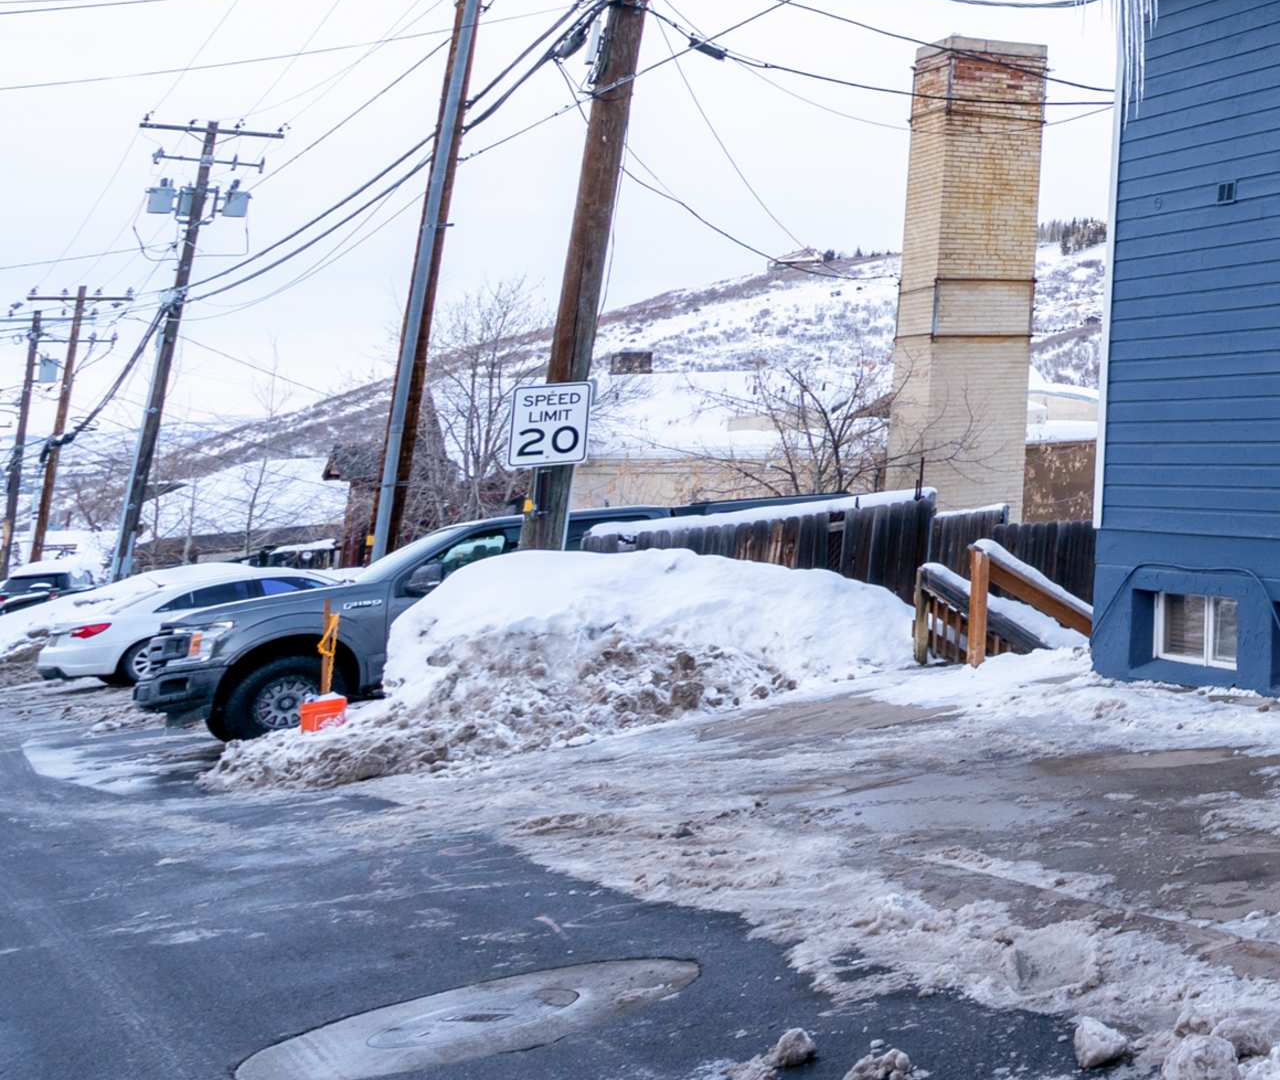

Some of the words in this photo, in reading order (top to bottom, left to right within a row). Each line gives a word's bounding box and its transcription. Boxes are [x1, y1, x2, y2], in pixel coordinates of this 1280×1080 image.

[522, 392, 581, 407] SPEED
[528, 409, 572, 423] LIMIT
[517, 425, 579, 457] 20
